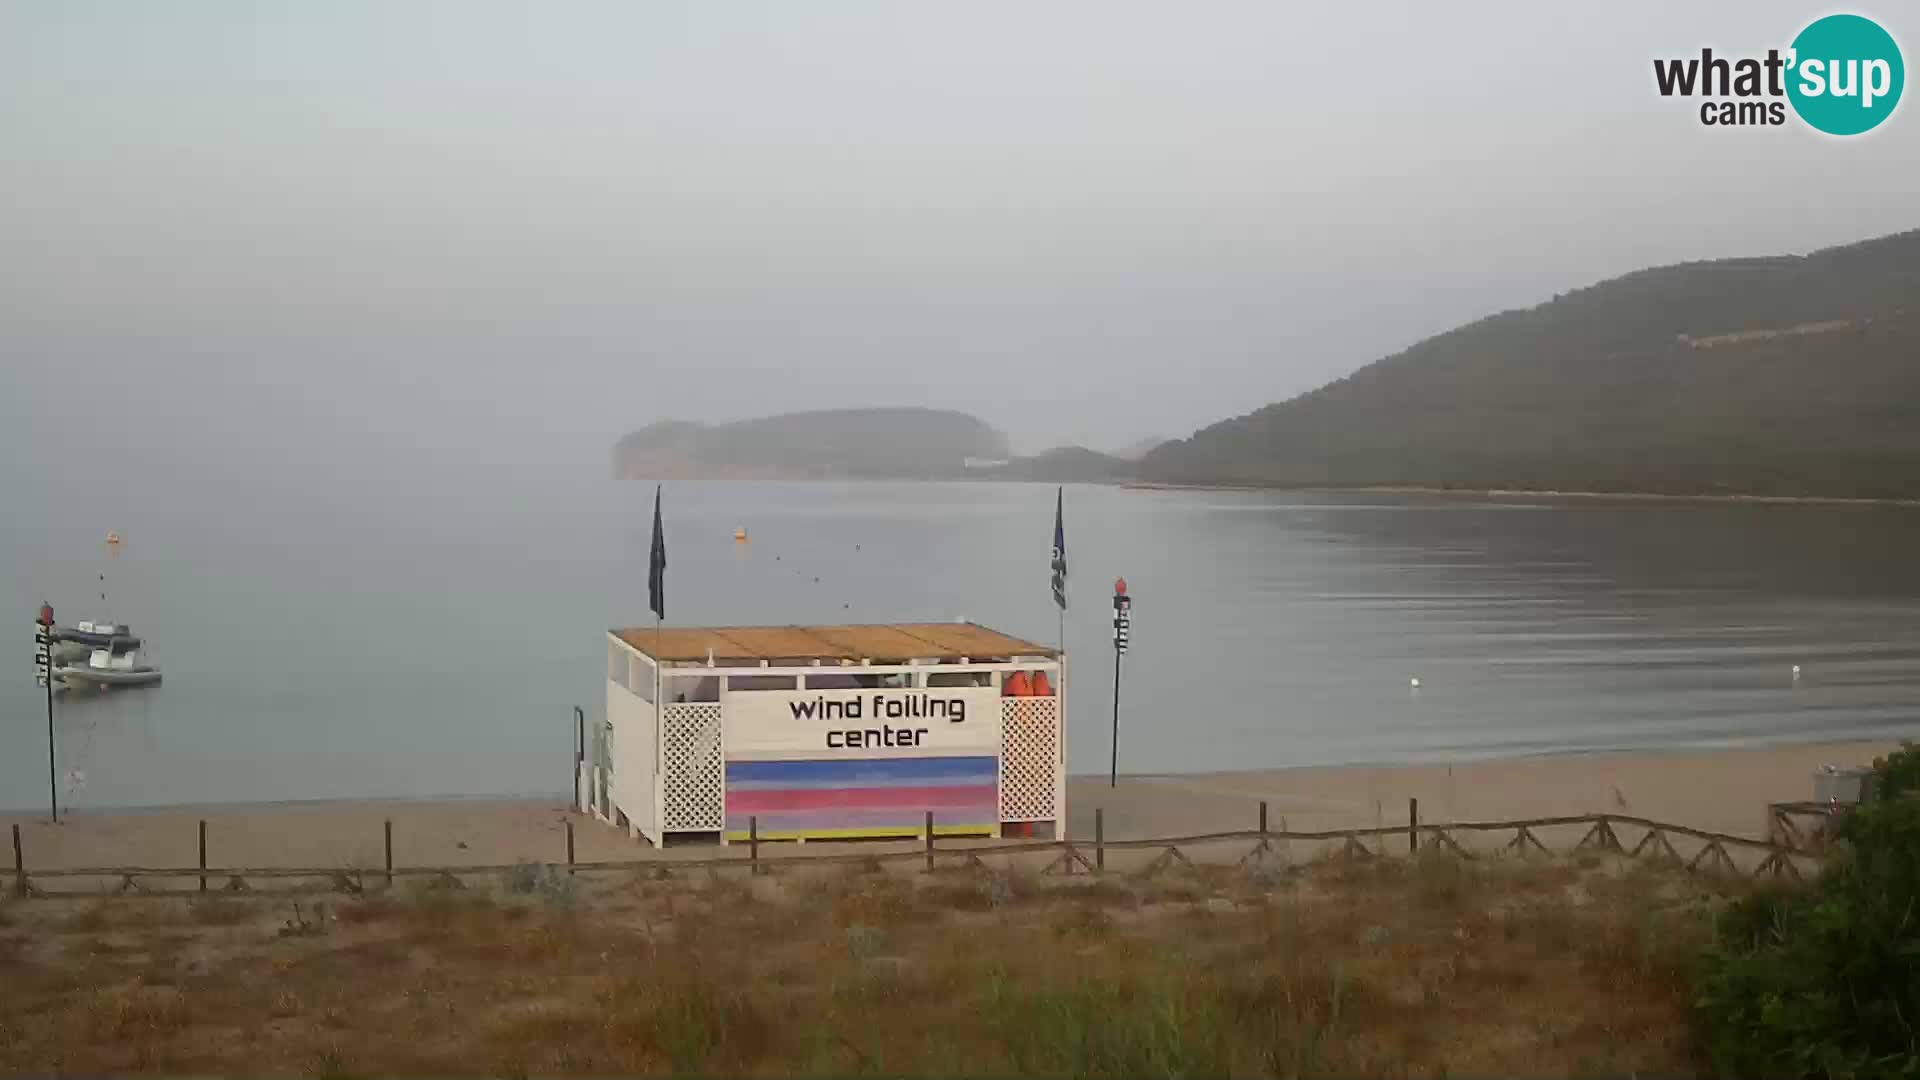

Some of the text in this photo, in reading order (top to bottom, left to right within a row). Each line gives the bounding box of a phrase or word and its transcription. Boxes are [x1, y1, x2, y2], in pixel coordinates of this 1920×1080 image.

[789, 694, 966, 723] wind foiling
[827, 724, 929, 748] center
